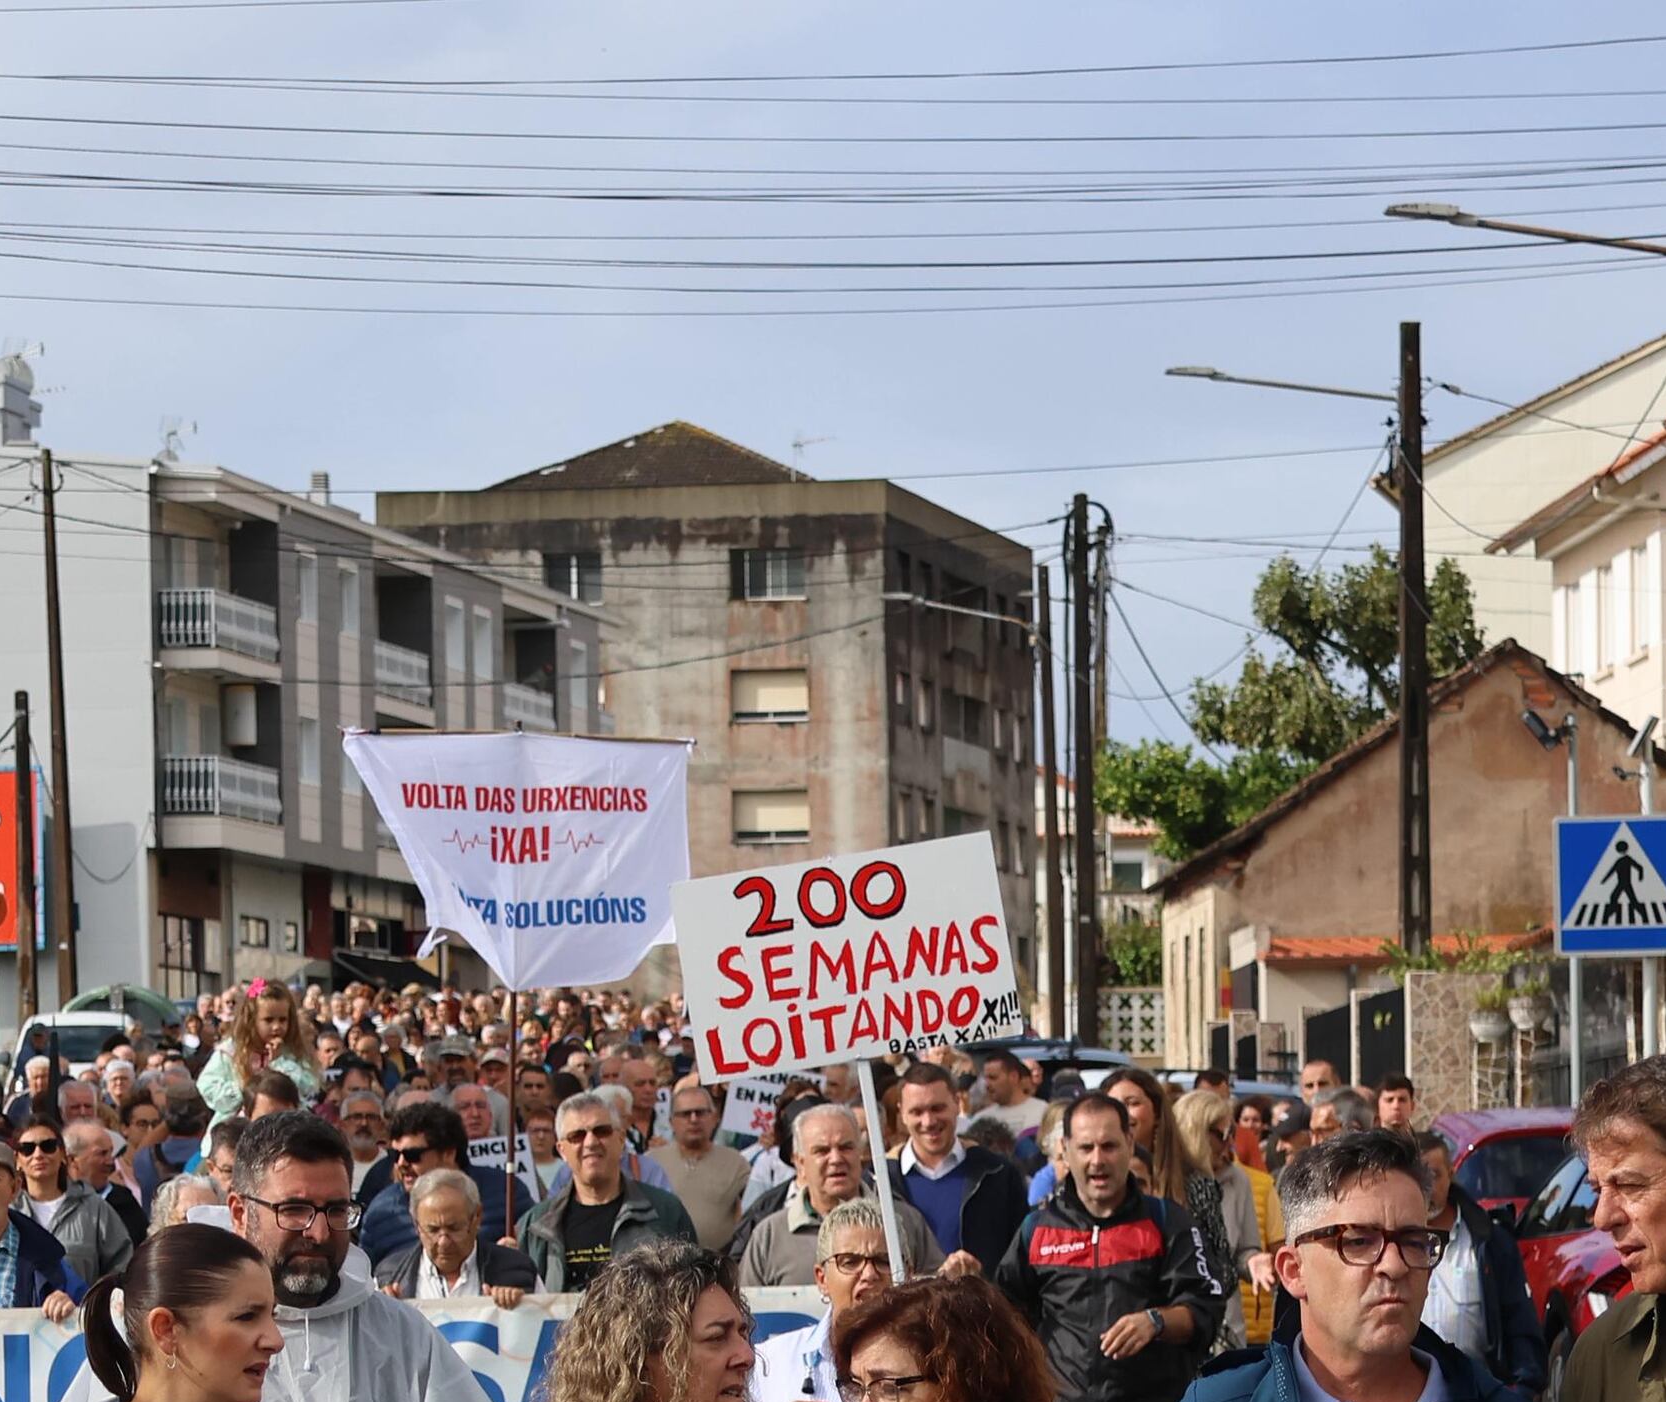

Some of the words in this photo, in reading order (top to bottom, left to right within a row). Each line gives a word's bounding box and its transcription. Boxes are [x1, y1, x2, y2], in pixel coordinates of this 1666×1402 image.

[402, 783, 467, 810] VOLTA
[475, 787, 516, 814] DAS
[522, 786, 648, 813] URXENCIAS
[505, 892, 647, 929] SOLUCIÓNS
[733, 860, 907, 937] 200
[717, 915, 1000, 1009] SEMANAS
[981, 990, 1021, 1026] XA!!
[889, 1033, 949, 1054] BASTA
